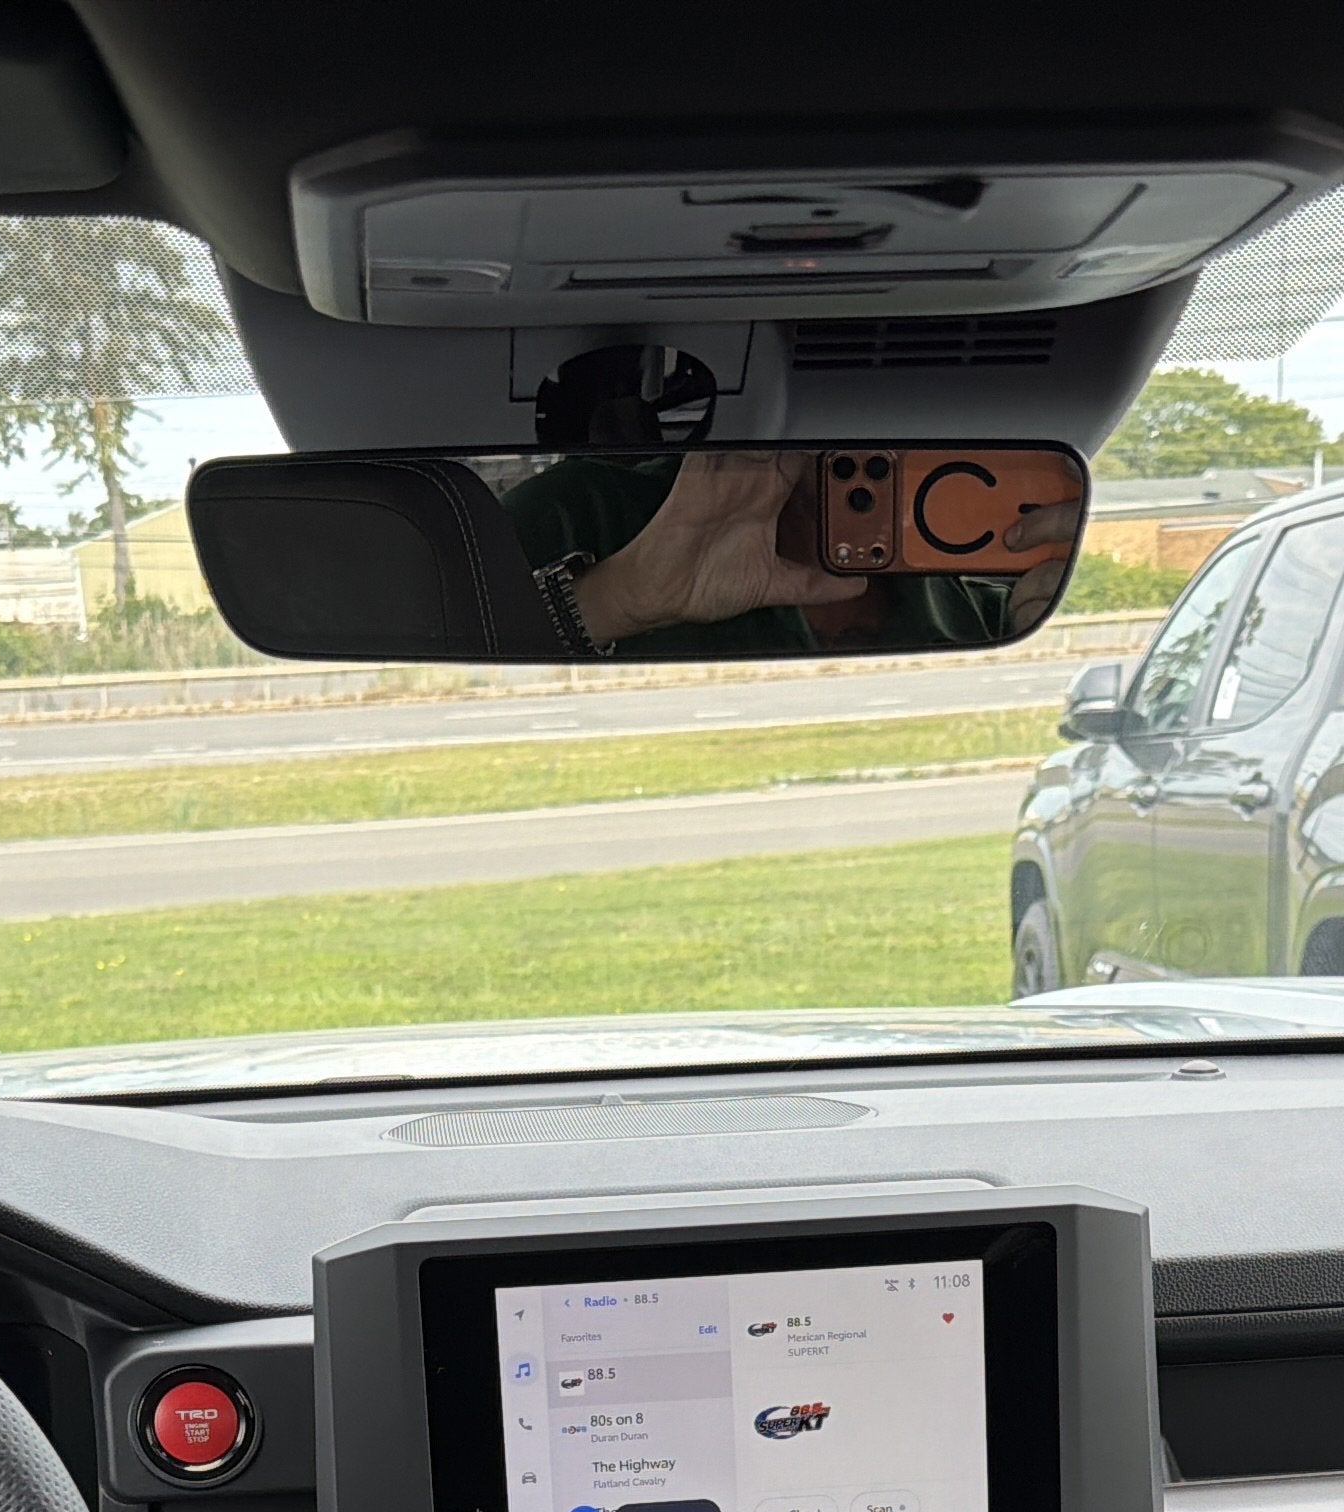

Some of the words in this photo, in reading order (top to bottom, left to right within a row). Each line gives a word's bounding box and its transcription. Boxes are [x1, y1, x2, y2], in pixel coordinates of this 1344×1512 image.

[934, 1274, 971, 1289] 11:08
[584, 1296, 617, 1307] Radio
[634, 1293, 659, 1304] 88.5
[786, 1317, 812, 1328] 88.5
[698, 1325, 718, 1335] Edit
[787, 1332, 825, 1343] Mexican
[827, 1329, 867, 1343] Regional
[561, 1332, 603, 1343] Favorites
[787, 1346, 830, 1357] SUPERKT
[587, 1368, 616, 1381] 88.5
[175, 1408, 218, 1420] TRD
[590, 1414, 613, 1427] 80s
[616, 1415, 633, 1426] on
[635, 1413, 644, 1424] 8
[184, 1422, 209, 1430] ENGINE
[759, 1417, 798, 1432] SUPER
[798, 1413, 830, 1432] KT
[185, 1428, 210, 1437] START
[591, 1433, 619, 1443] Duran
[621, 1432, 649, 1442] Duran
[187, 1435, 210, 1444] STOP
[592, 1461, 616, 1473] The
[619, 1458, 676, 1474] Highway
[593, 1479, 630, 1489] Flatland
[632, 1477, 666, 1488] Cavalry
